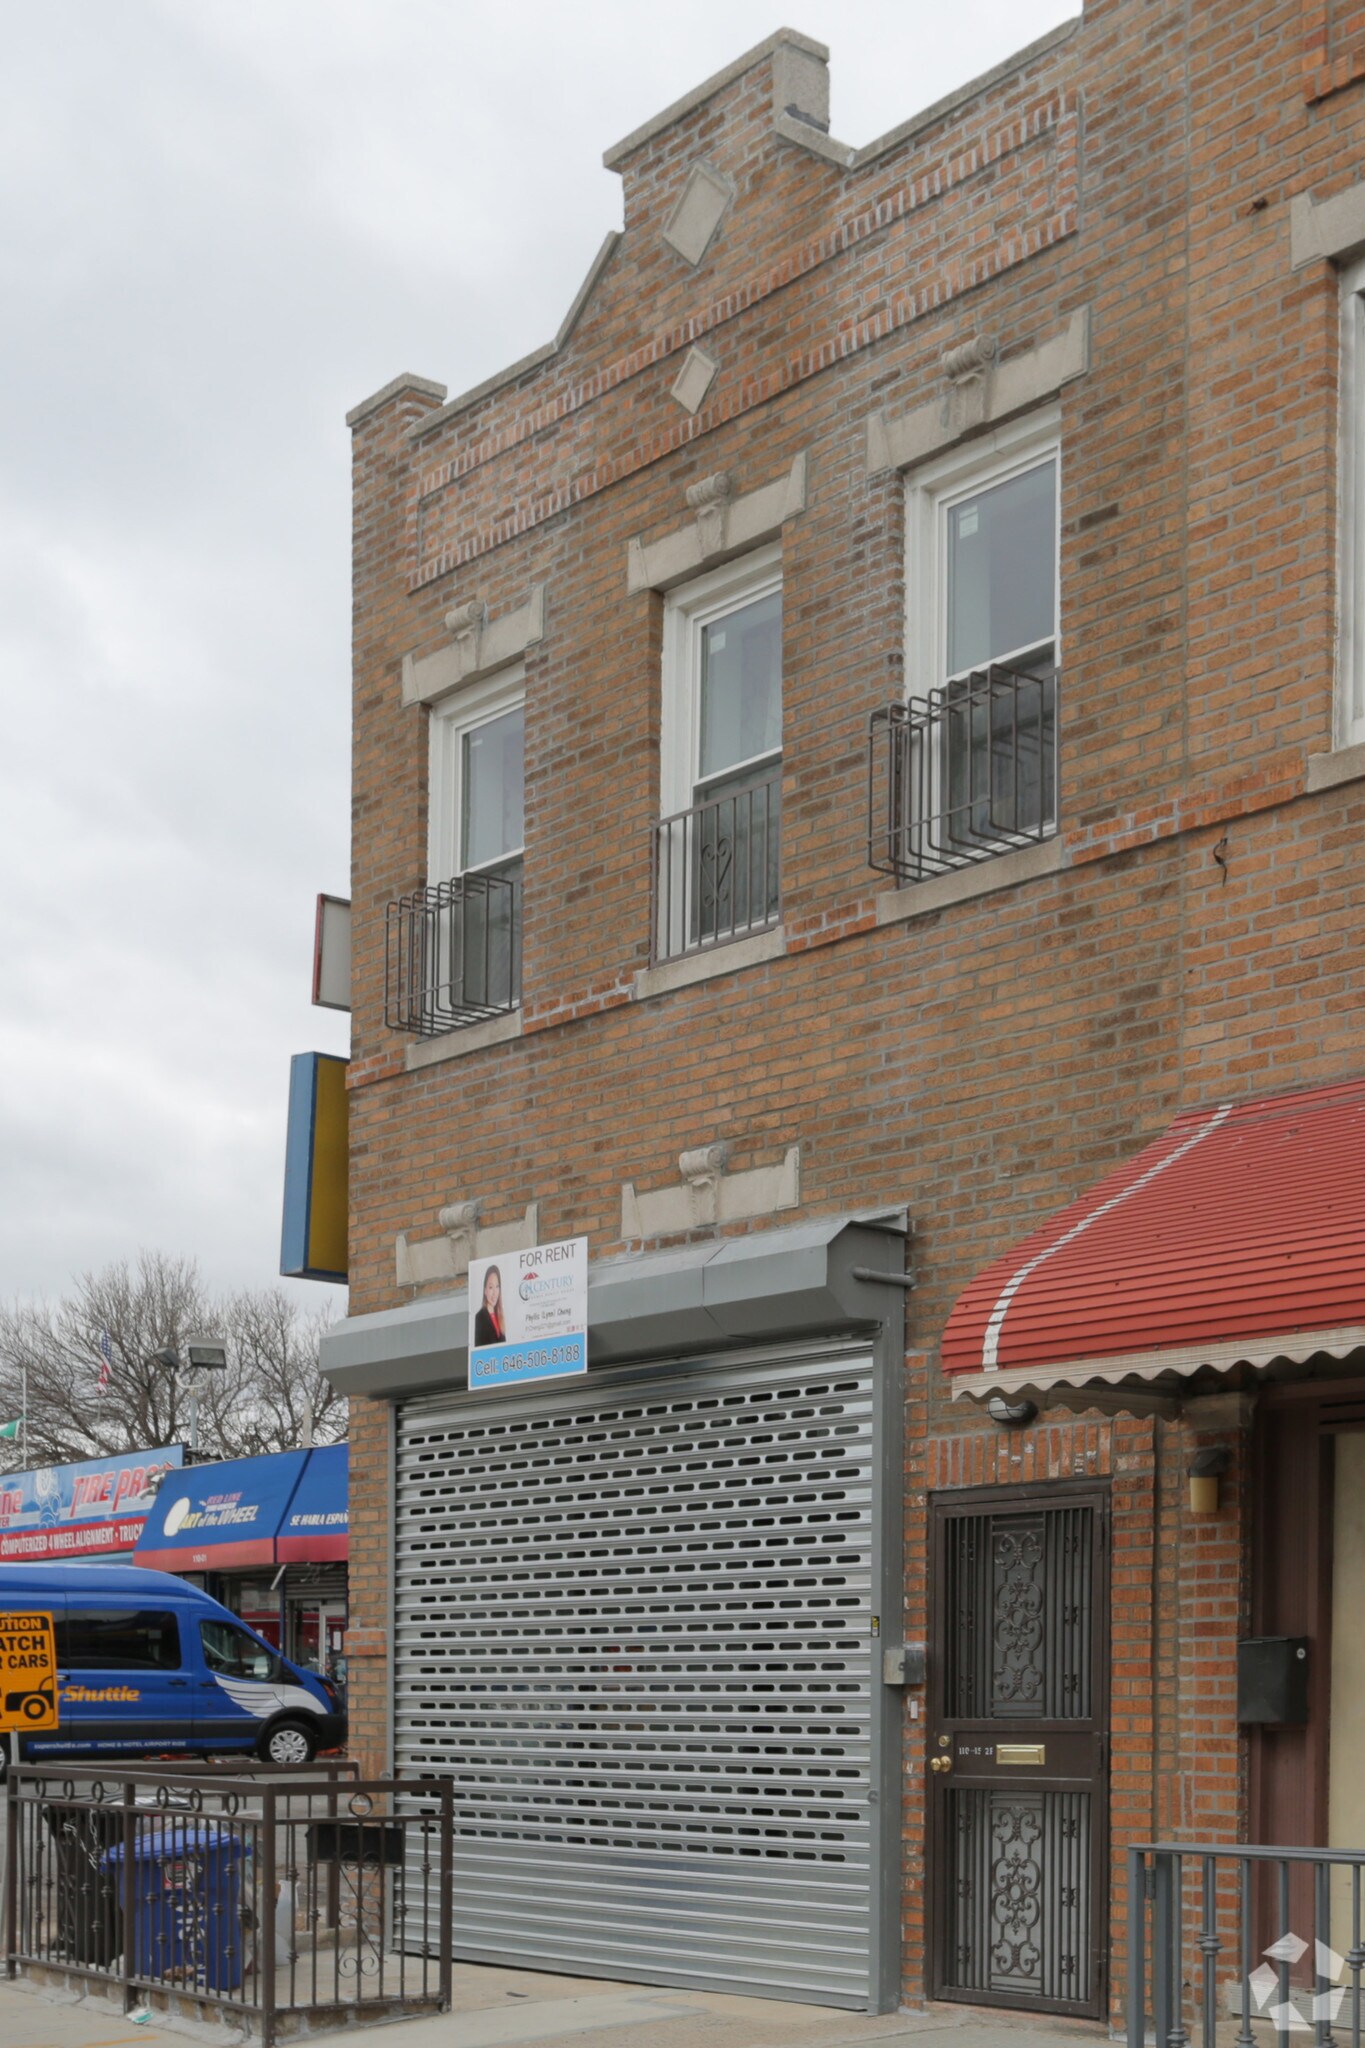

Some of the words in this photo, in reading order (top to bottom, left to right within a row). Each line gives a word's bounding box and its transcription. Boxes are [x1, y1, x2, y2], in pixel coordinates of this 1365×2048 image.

[520, 1250, 543, 1269] FOR
[545, 1243, 577, 1263] RENT
[533, 1275, 573, 1292] CENTURY
[475, 1358, 499, 1377] Cell:
[502, 1344, 580, 1372] 646-506-8188
[69, 1472, 116, 1518] TIRE
[217, 1504, 259, 1526] WHEEL
[289, 1514, 301, 1526] SE
[300, 1513, 325, 1526] HABLA
[1, 1536, 48, 1555] COMPUTERIZED
[53, 1532, 75, 1550] WHEEL
[75, 1527, 115, 1548] ALIGNMENT
[8, 1653, 49, 1669] CARS
